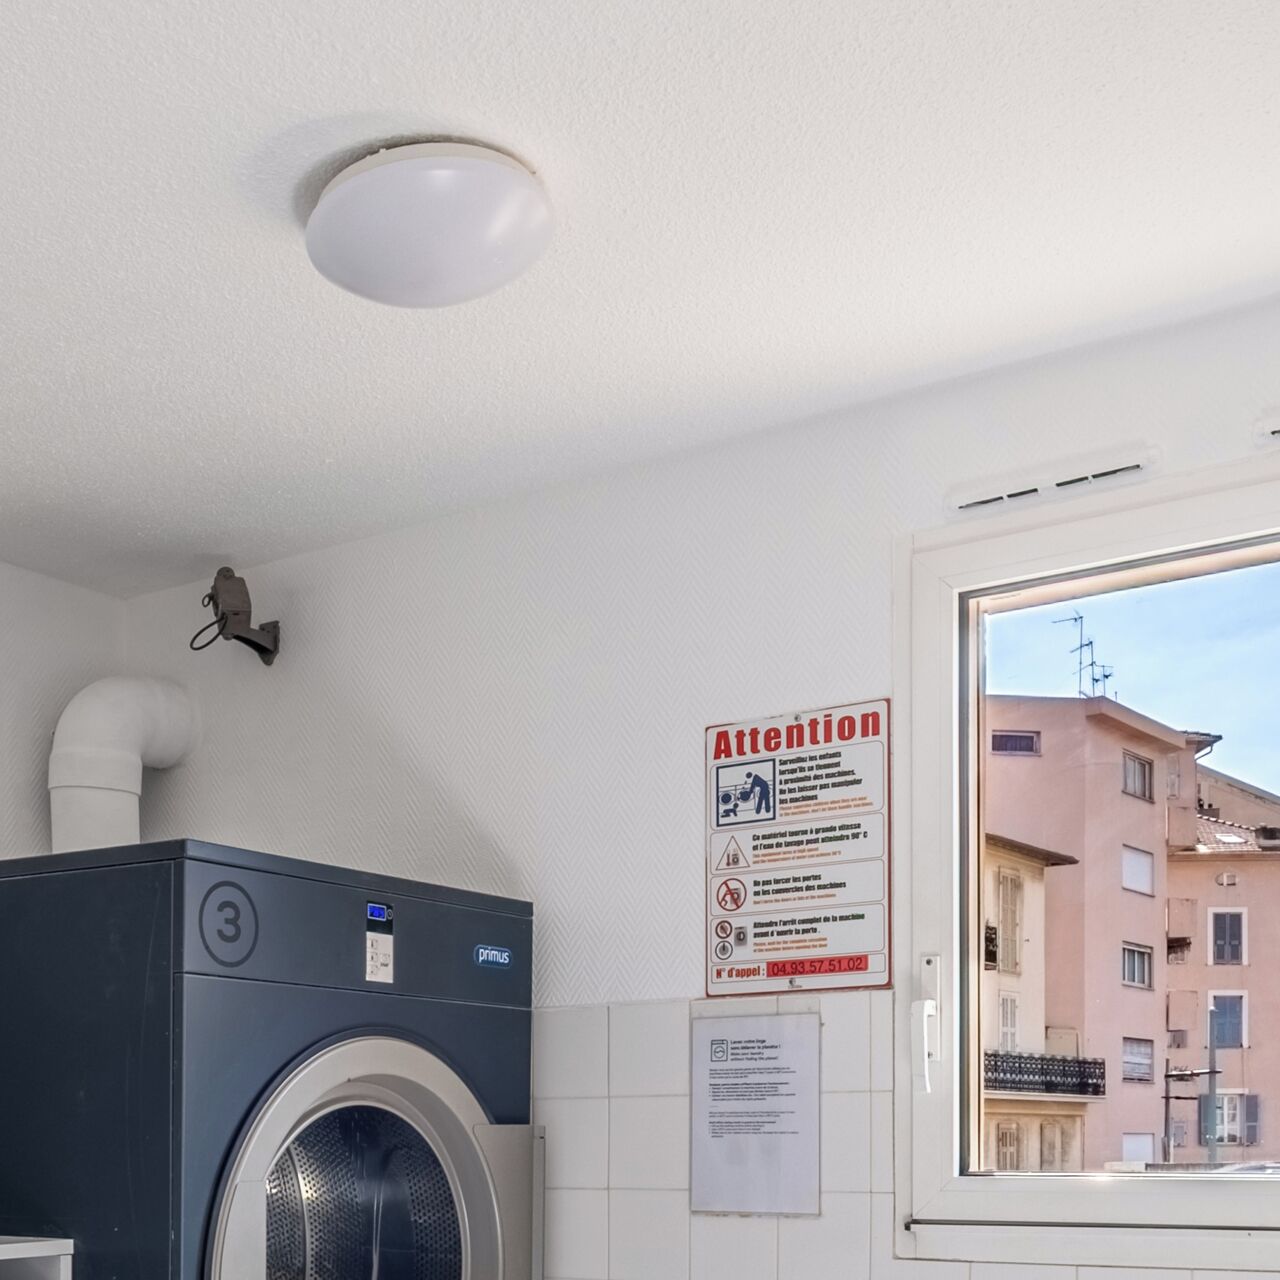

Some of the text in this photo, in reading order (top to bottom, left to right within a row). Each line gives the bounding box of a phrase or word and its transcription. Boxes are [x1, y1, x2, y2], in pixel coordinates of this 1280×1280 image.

[714, 711, 880, 760] Attention
[216, 900, 242, 944] 3
[478, 947, 509, 964] primus
[728, 966, 760, 978] d'appel
[772, 957, 863, 976] 04.93.57.51.02
